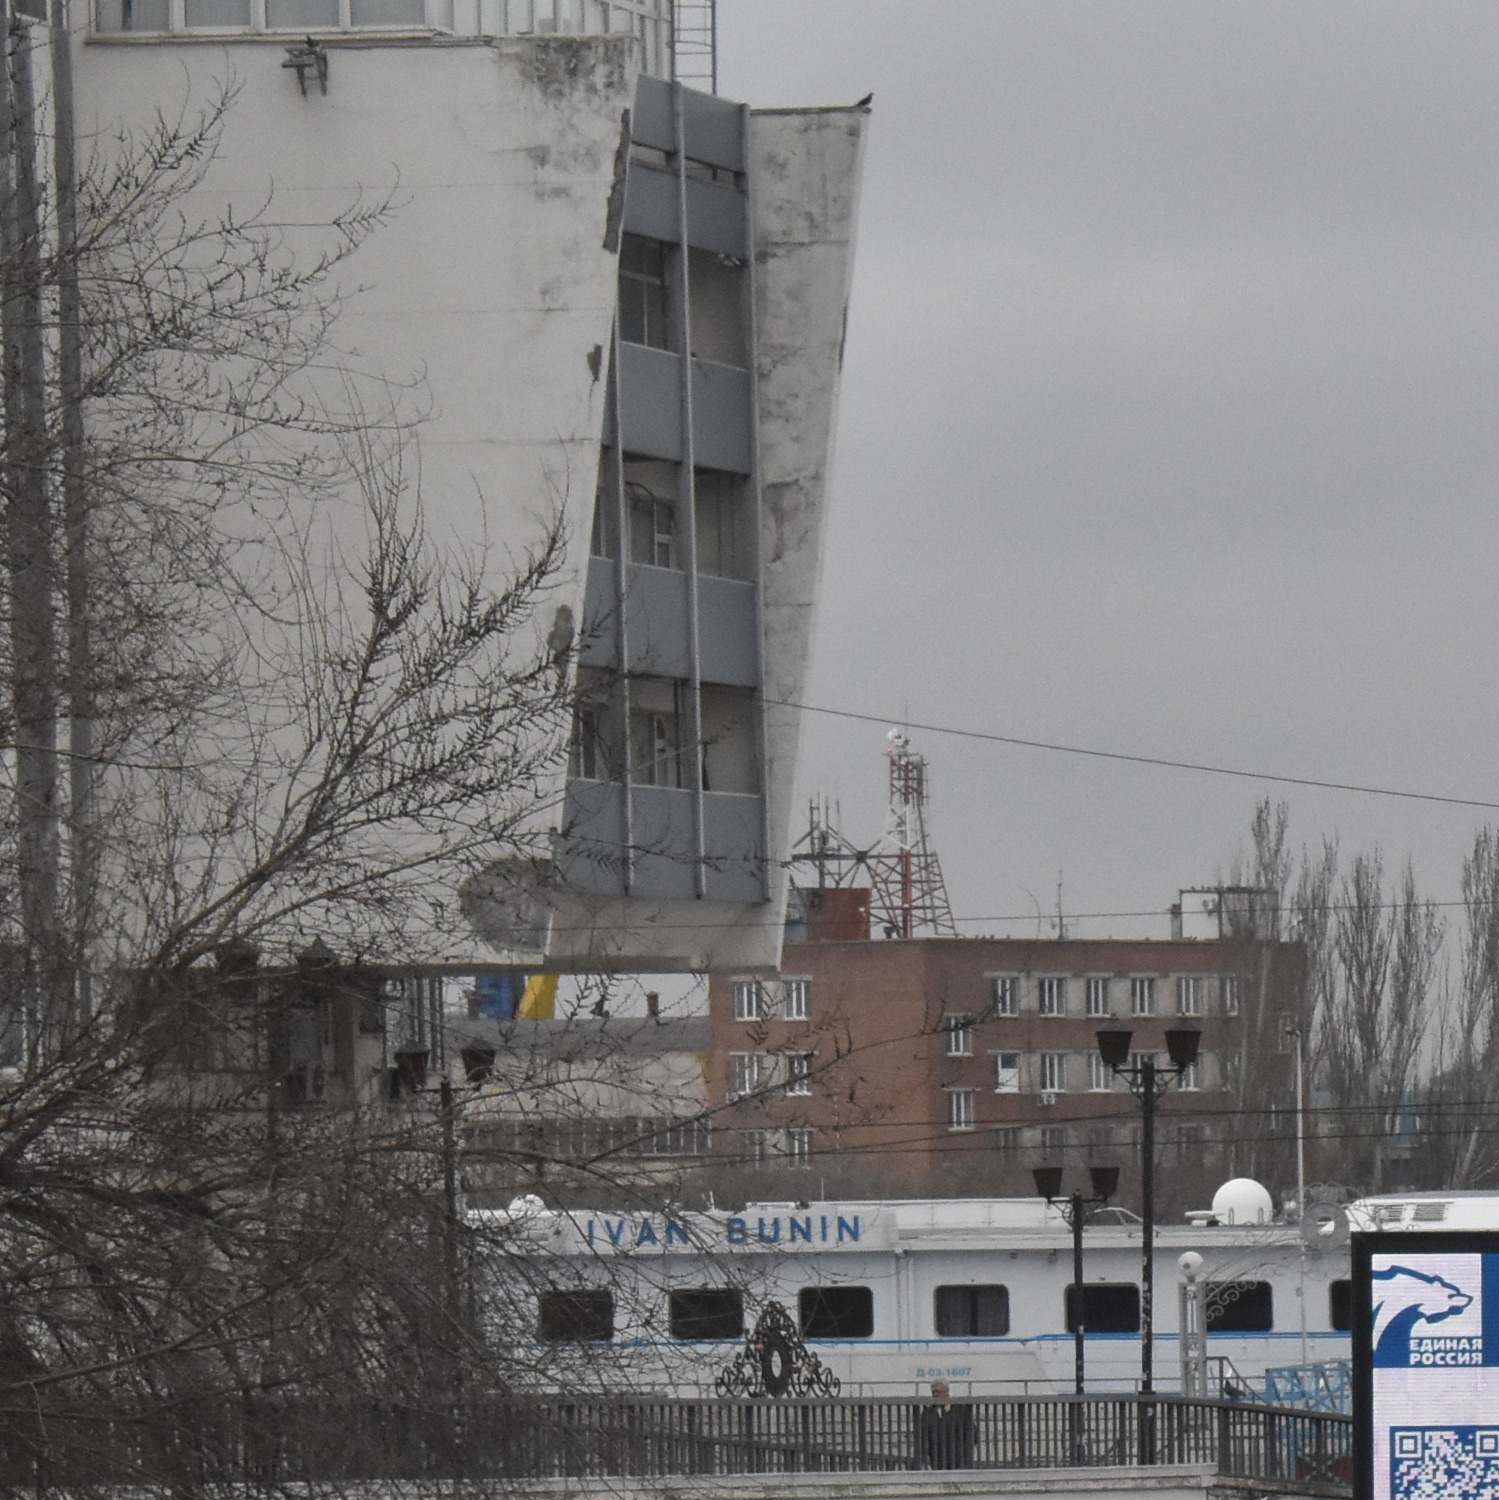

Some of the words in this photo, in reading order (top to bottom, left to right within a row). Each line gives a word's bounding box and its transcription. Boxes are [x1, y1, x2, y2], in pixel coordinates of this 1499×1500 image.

[587, 1217, 690, 1247] IVAN
[726, 1215, 860, 1245] BUNIN
[1409, 1339, 1483, 1352] ЕДИНАЯ
[1409, 1352, 1483, 1365] РОССИЯ
